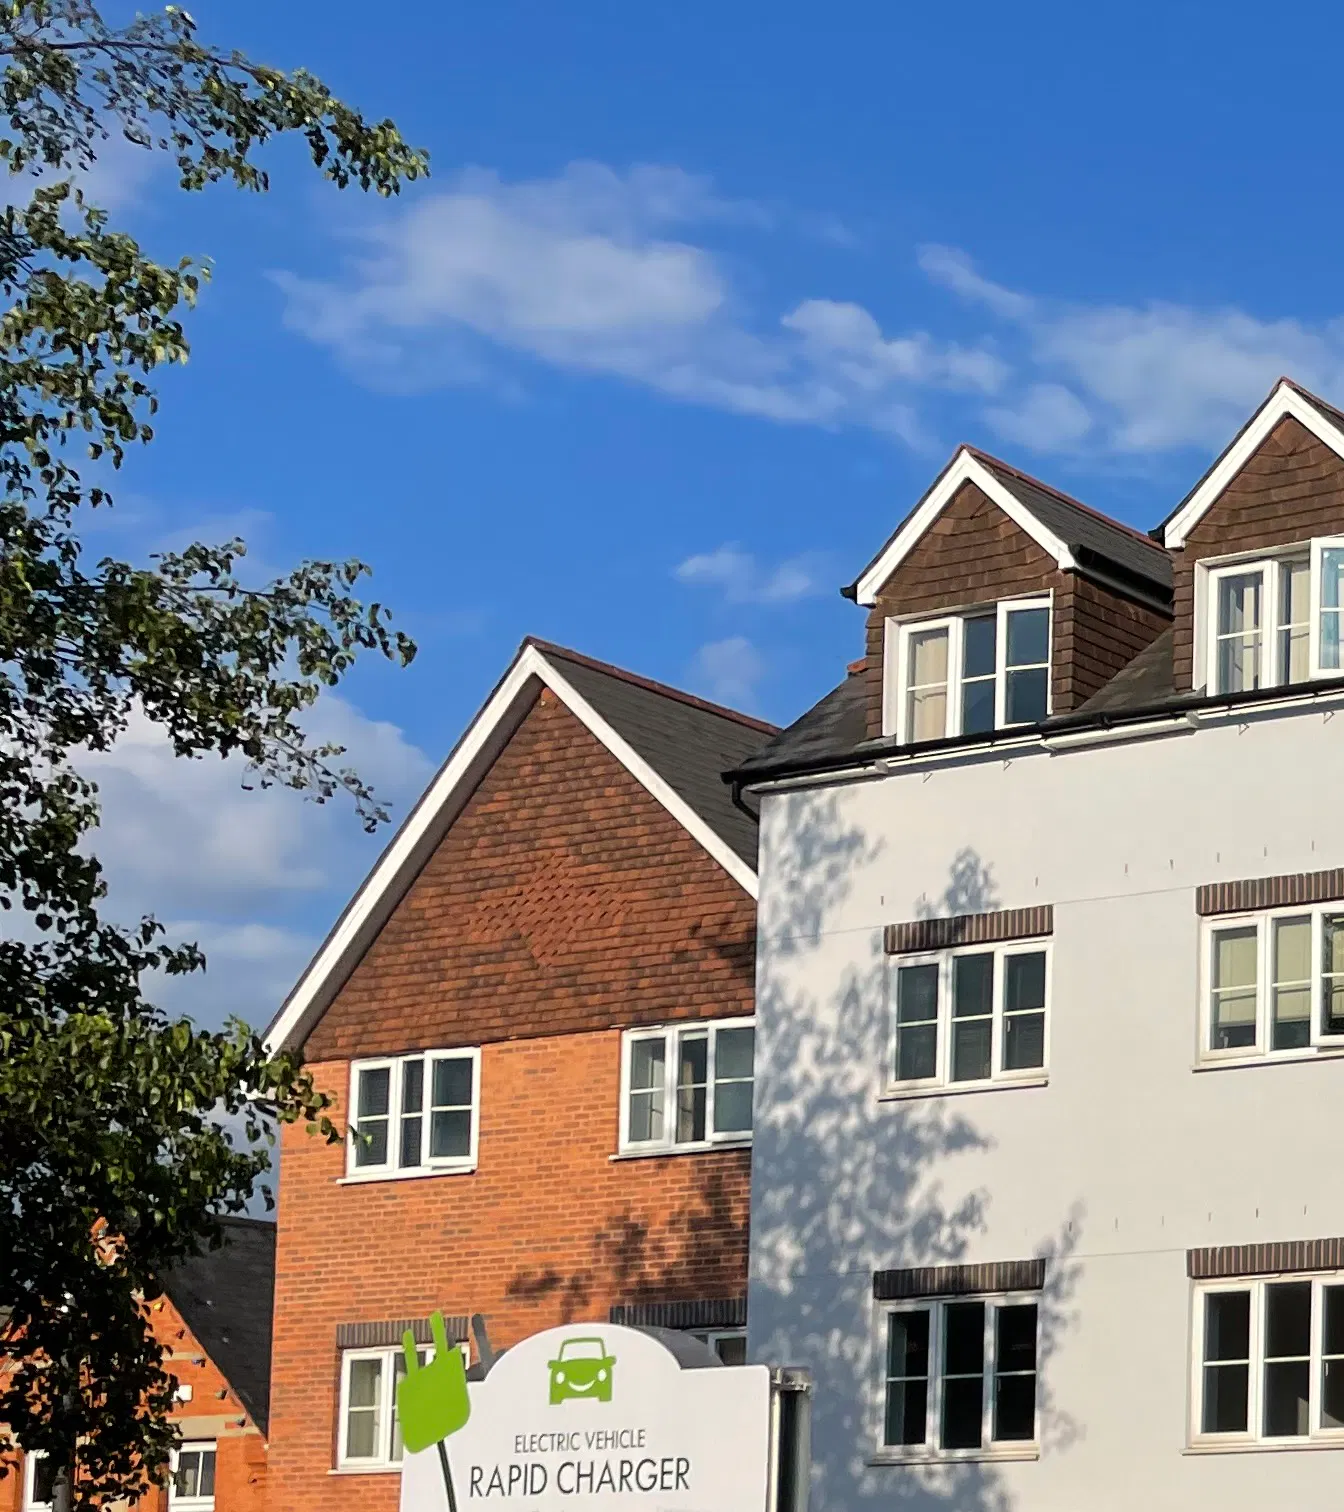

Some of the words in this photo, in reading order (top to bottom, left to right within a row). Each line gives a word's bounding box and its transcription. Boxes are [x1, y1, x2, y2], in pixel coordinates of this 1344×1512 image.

[514, 1431, 580, 1453] ELECTRIC
[585, 1429, 646, 1450] VEHICLE
[469, 1463, 548, 1498] RAPID
[557, 1457, 690, 1495] CHARGER
